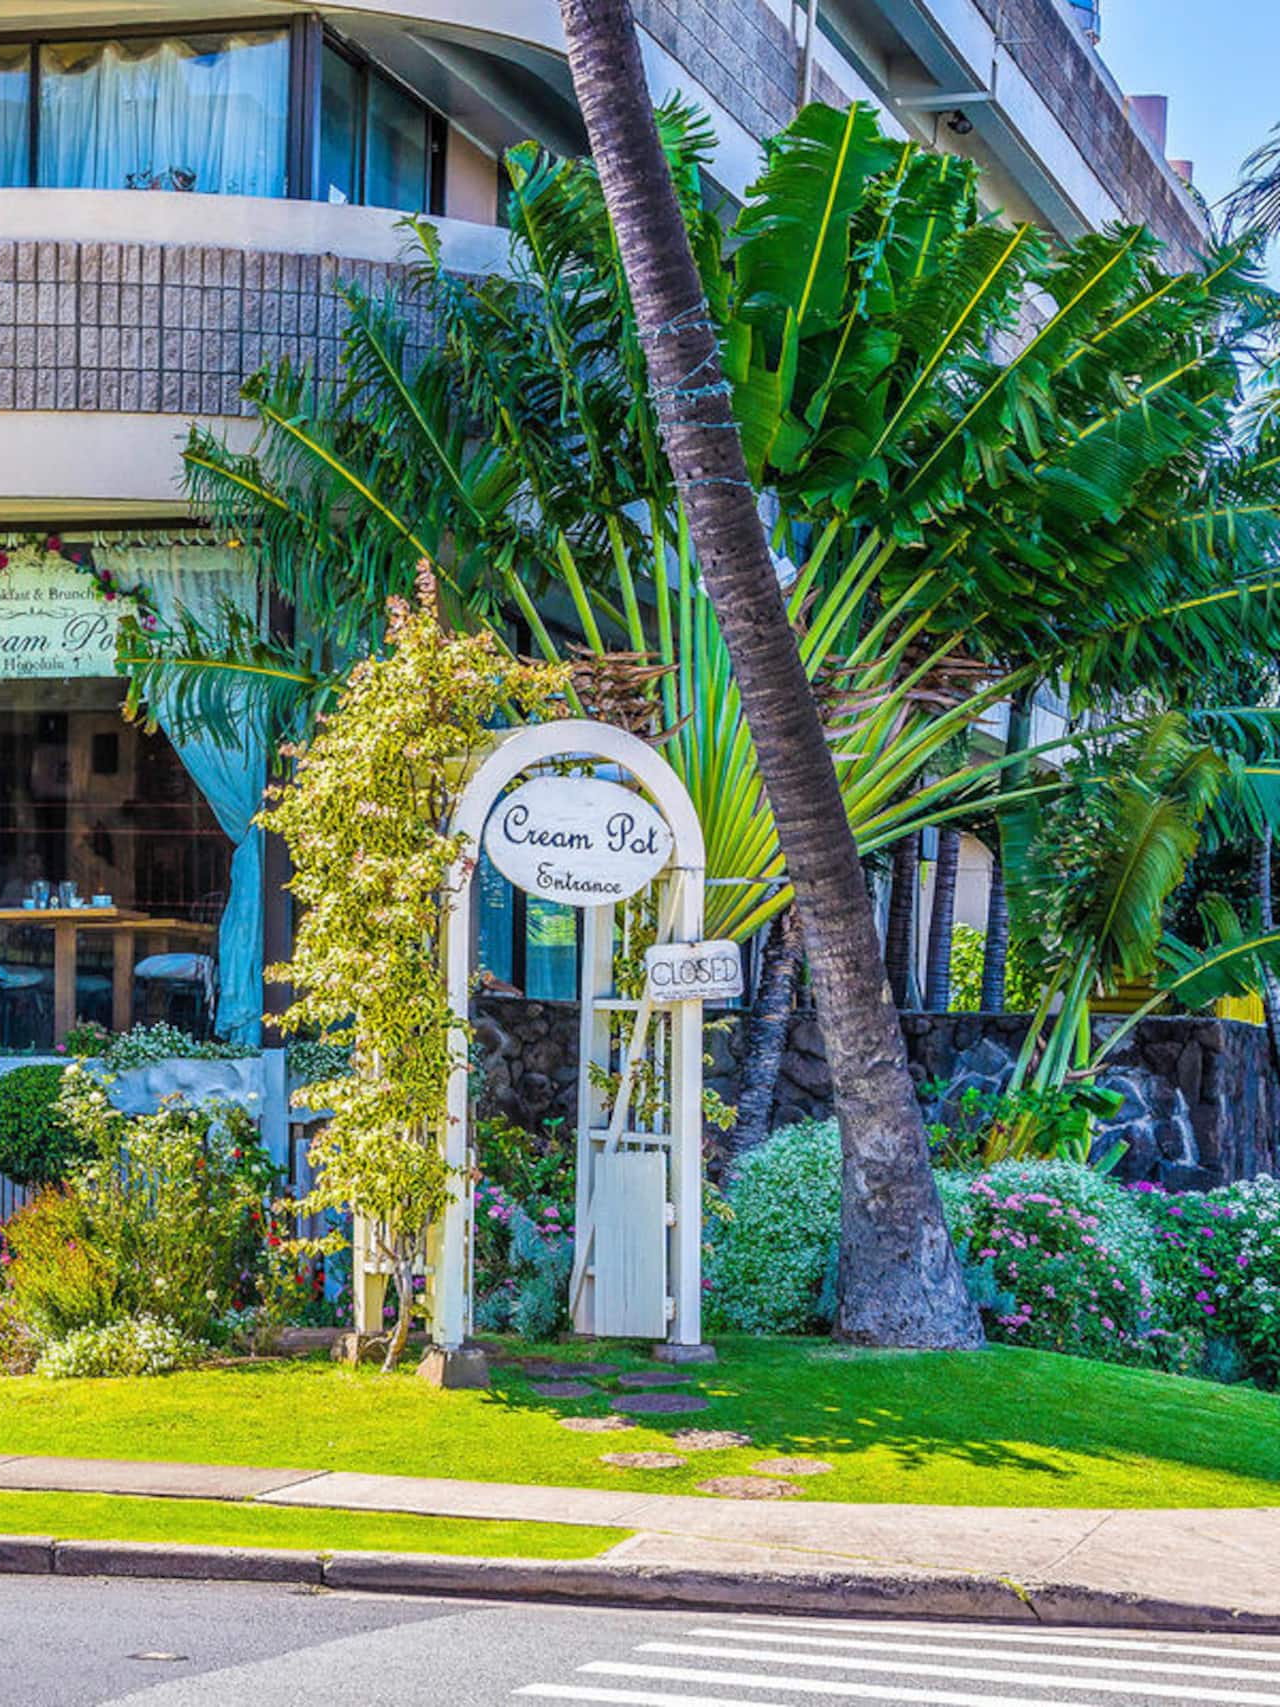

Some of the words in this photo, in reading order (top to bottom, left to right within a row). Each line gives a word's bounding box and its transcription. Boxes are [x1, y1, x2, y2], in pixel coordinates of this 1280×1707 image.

[33, 588, 43, 600] &
[48, 586, 94, 600] Brunch
[62, 612, 117, 652] Po
[503, 804, 593, 850] Cream
[607, 812, 658, 854] Pot
[537, 862, 623, 895] Entrance
[650, 957, 738, 986] CLOSED
